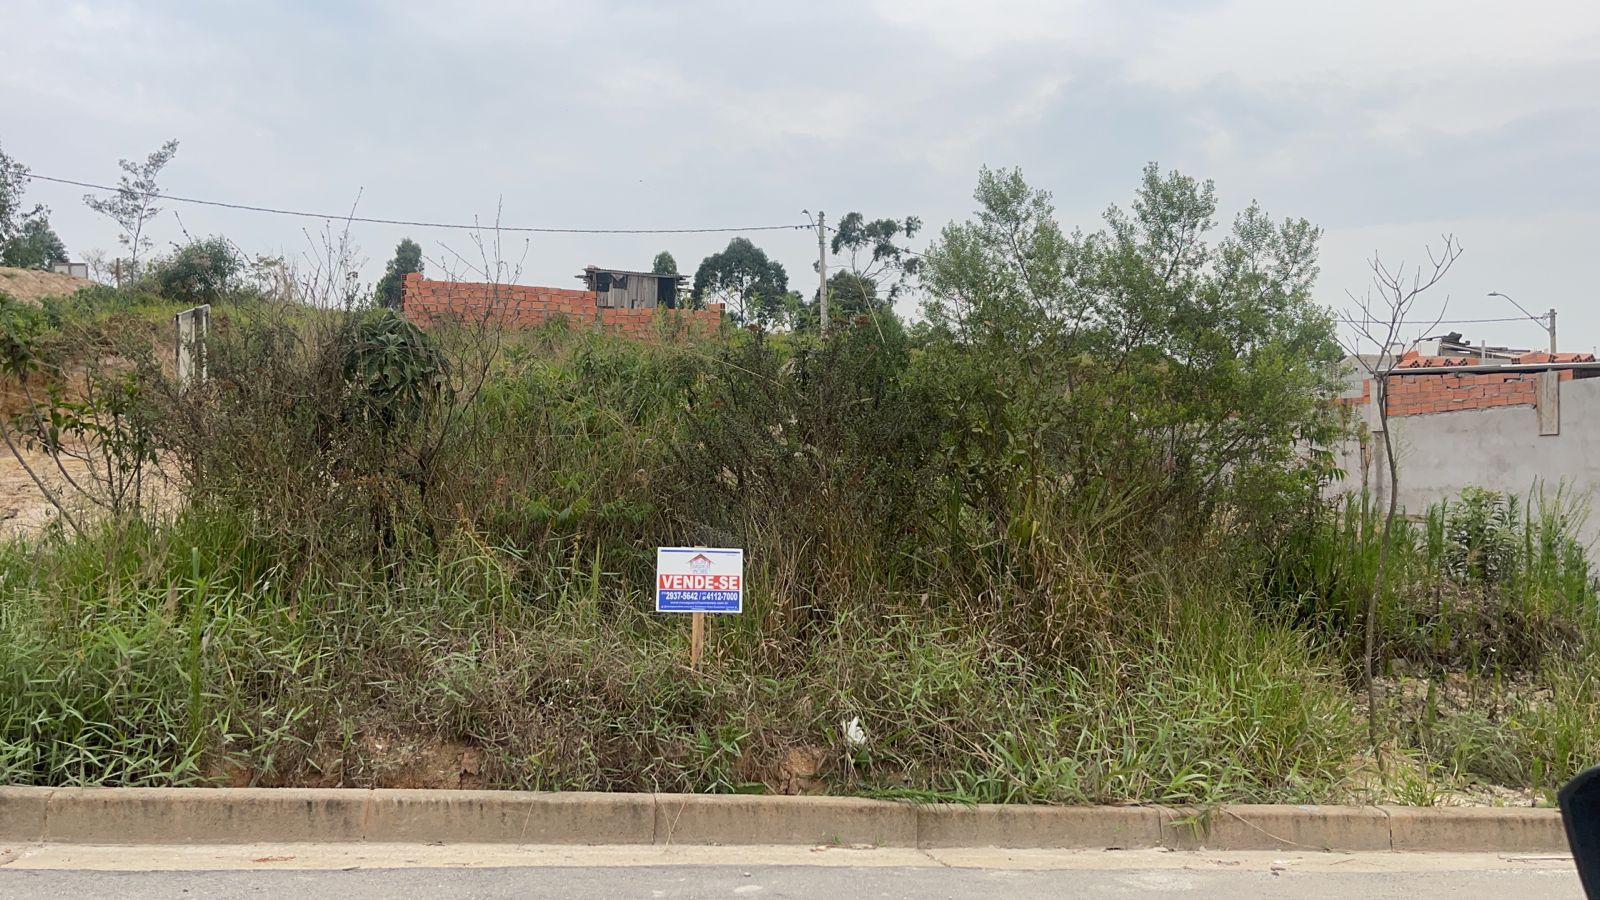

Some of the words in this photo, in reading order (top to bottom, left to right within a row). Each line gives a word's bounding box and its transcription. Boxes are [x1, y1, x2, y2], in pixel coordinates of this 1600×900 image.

[662, 575, 738, 590] VENDE-SE
[666, 591, 698, 600] 2937-5642
[706, 592, 738, 601] 4112-7000
